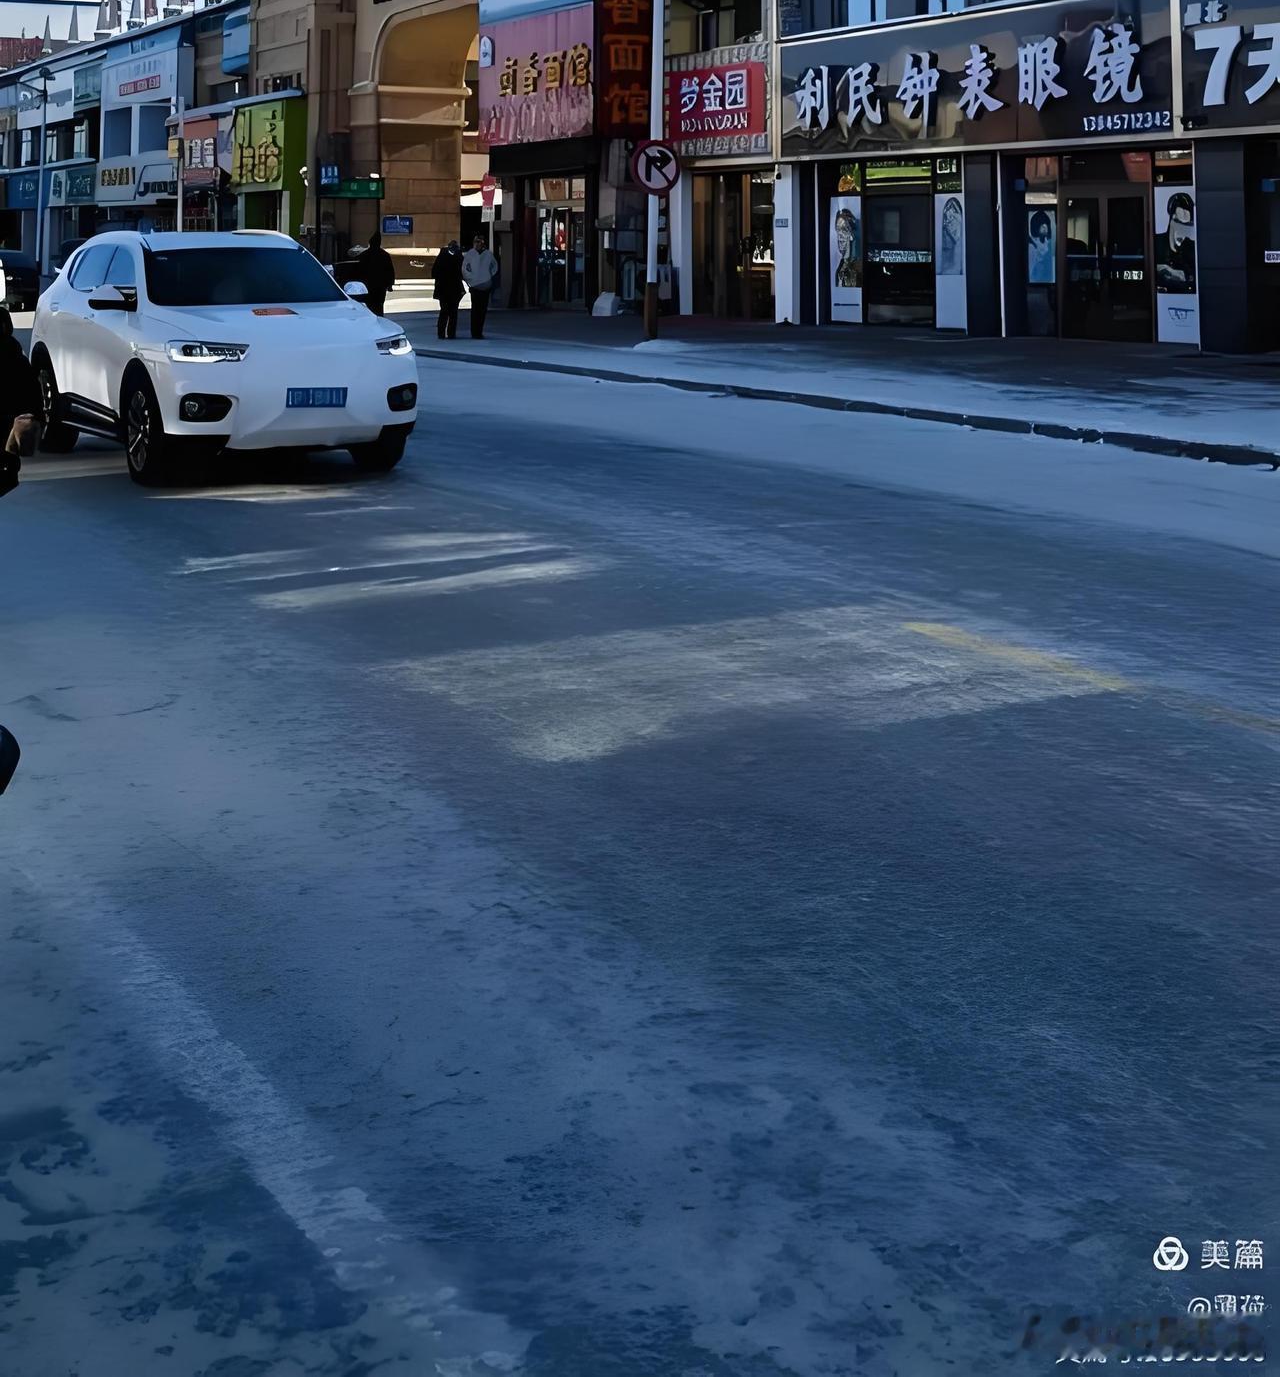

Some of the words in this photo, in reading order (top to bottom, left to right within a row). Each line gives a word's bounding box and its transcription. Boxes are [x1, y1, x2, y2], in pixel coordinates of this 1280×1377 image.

[680, 69, 748, 114] 梦金园
[795, 24, 1145, 139] 利民钟表眼镜
